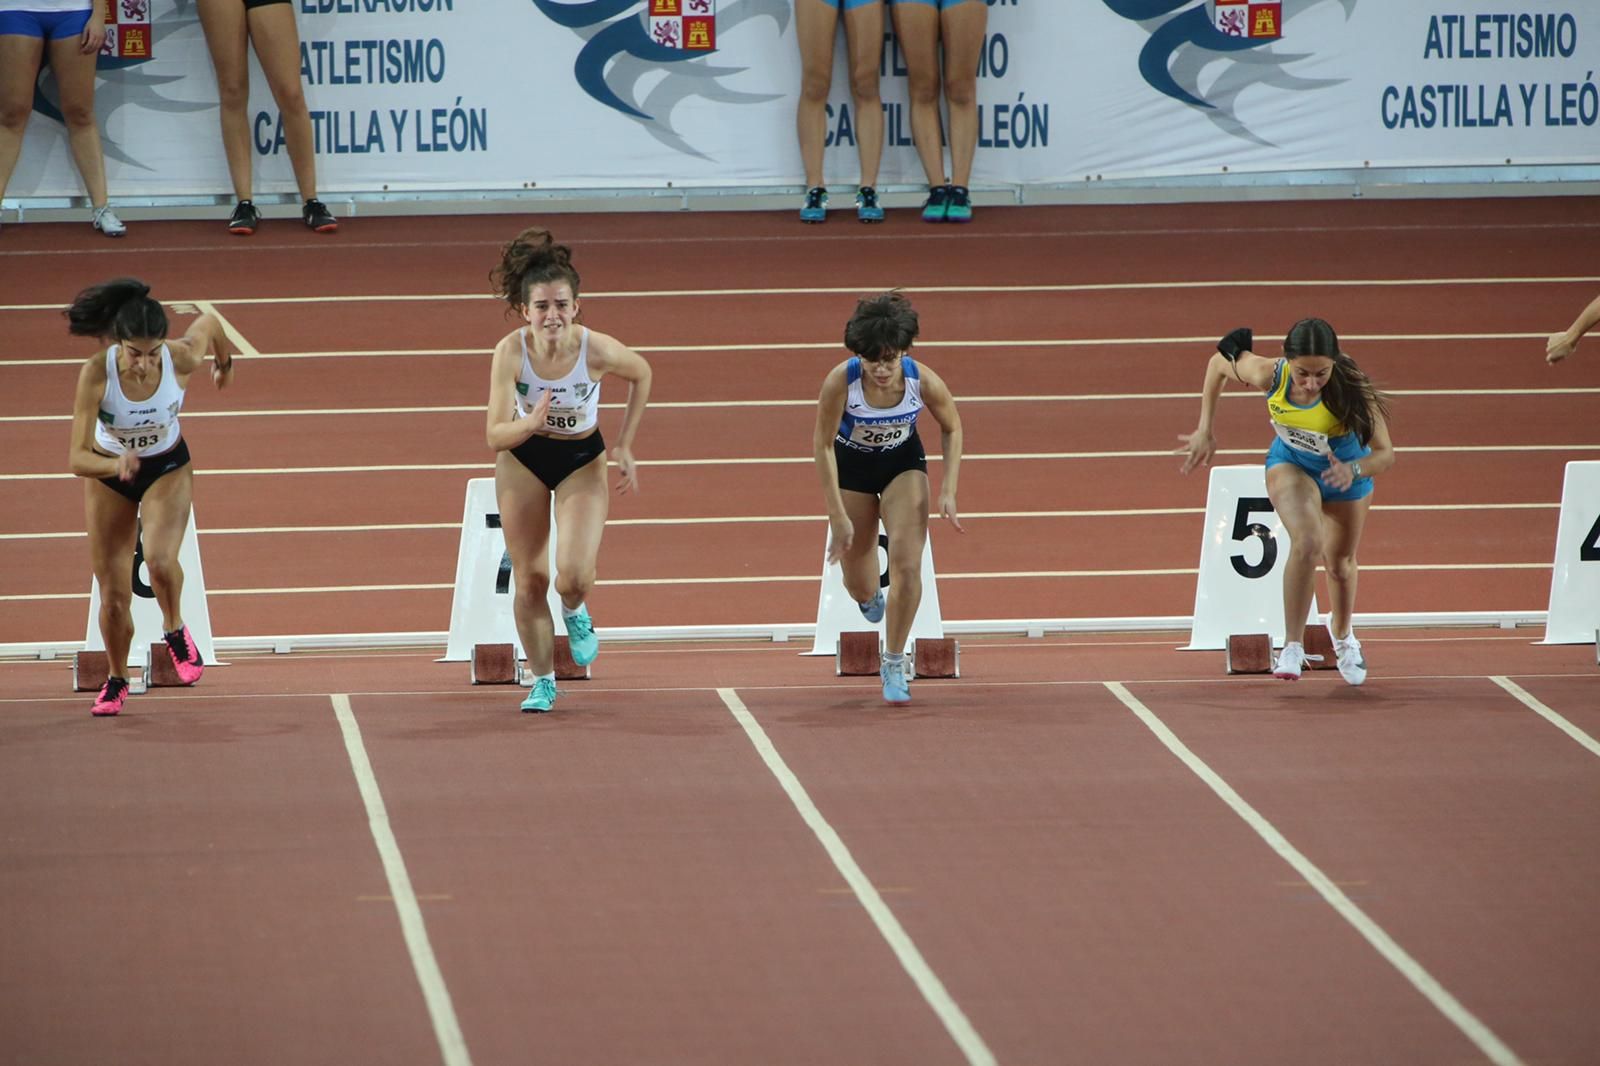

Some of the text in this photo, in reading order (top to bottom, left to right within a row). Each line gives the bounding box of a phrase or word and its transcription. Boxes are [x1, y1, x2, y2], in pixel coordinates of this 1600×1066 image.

[300, 38, 445, 85] ATLETISMO
[1424, 13, 1577, 59] ATLETISMO
[254, 96, 488, 155] CATILLA Y LEÓN
[978, 92, 1049, 149] LEÓN
[1381, 84, 1514, 130] CASTILLA
[1519, 84, 1538, 126] Y
[1230, 497, 1278, 579] 5
